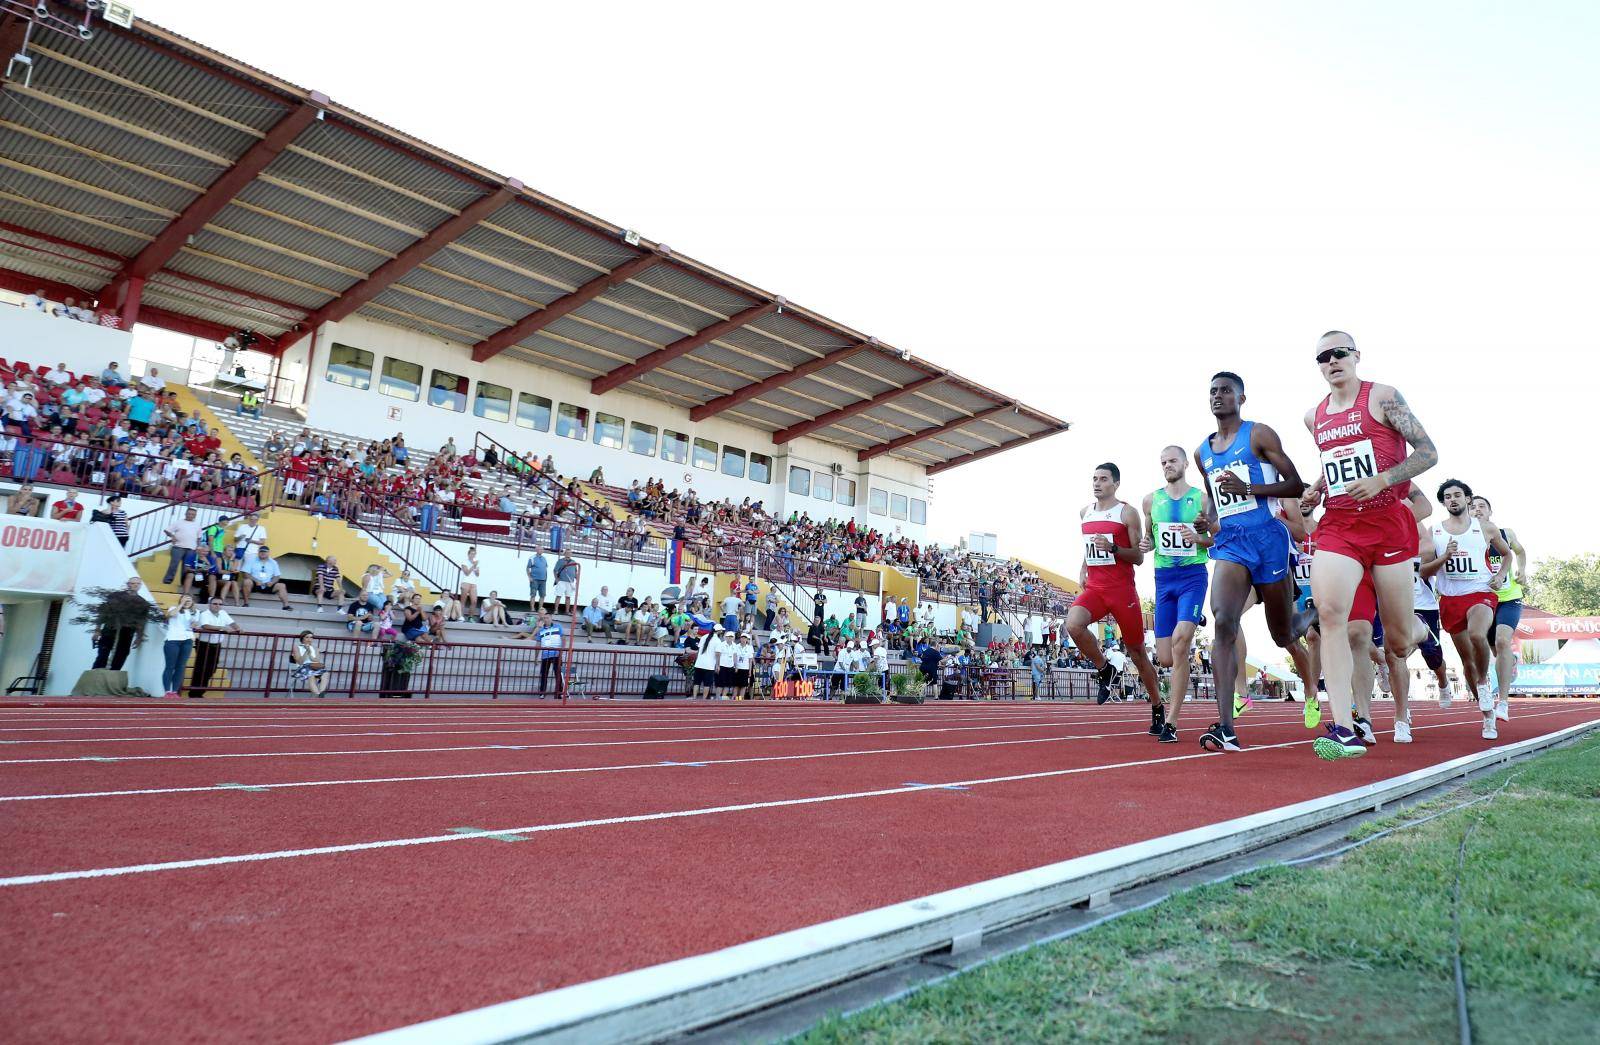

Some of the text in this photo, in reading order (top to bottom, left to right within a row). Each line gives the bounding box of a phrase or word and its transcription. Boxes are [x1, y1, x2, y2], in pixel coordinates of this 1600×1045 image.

[1318, 423, 1363, 444] DANMARK
[1325, 454, 1374, 486] DEN
[1, 525, 70, 552] OBODA
[1295, 565, 1312, 580] LU
[1445, 558, 1478, 573] BUL
